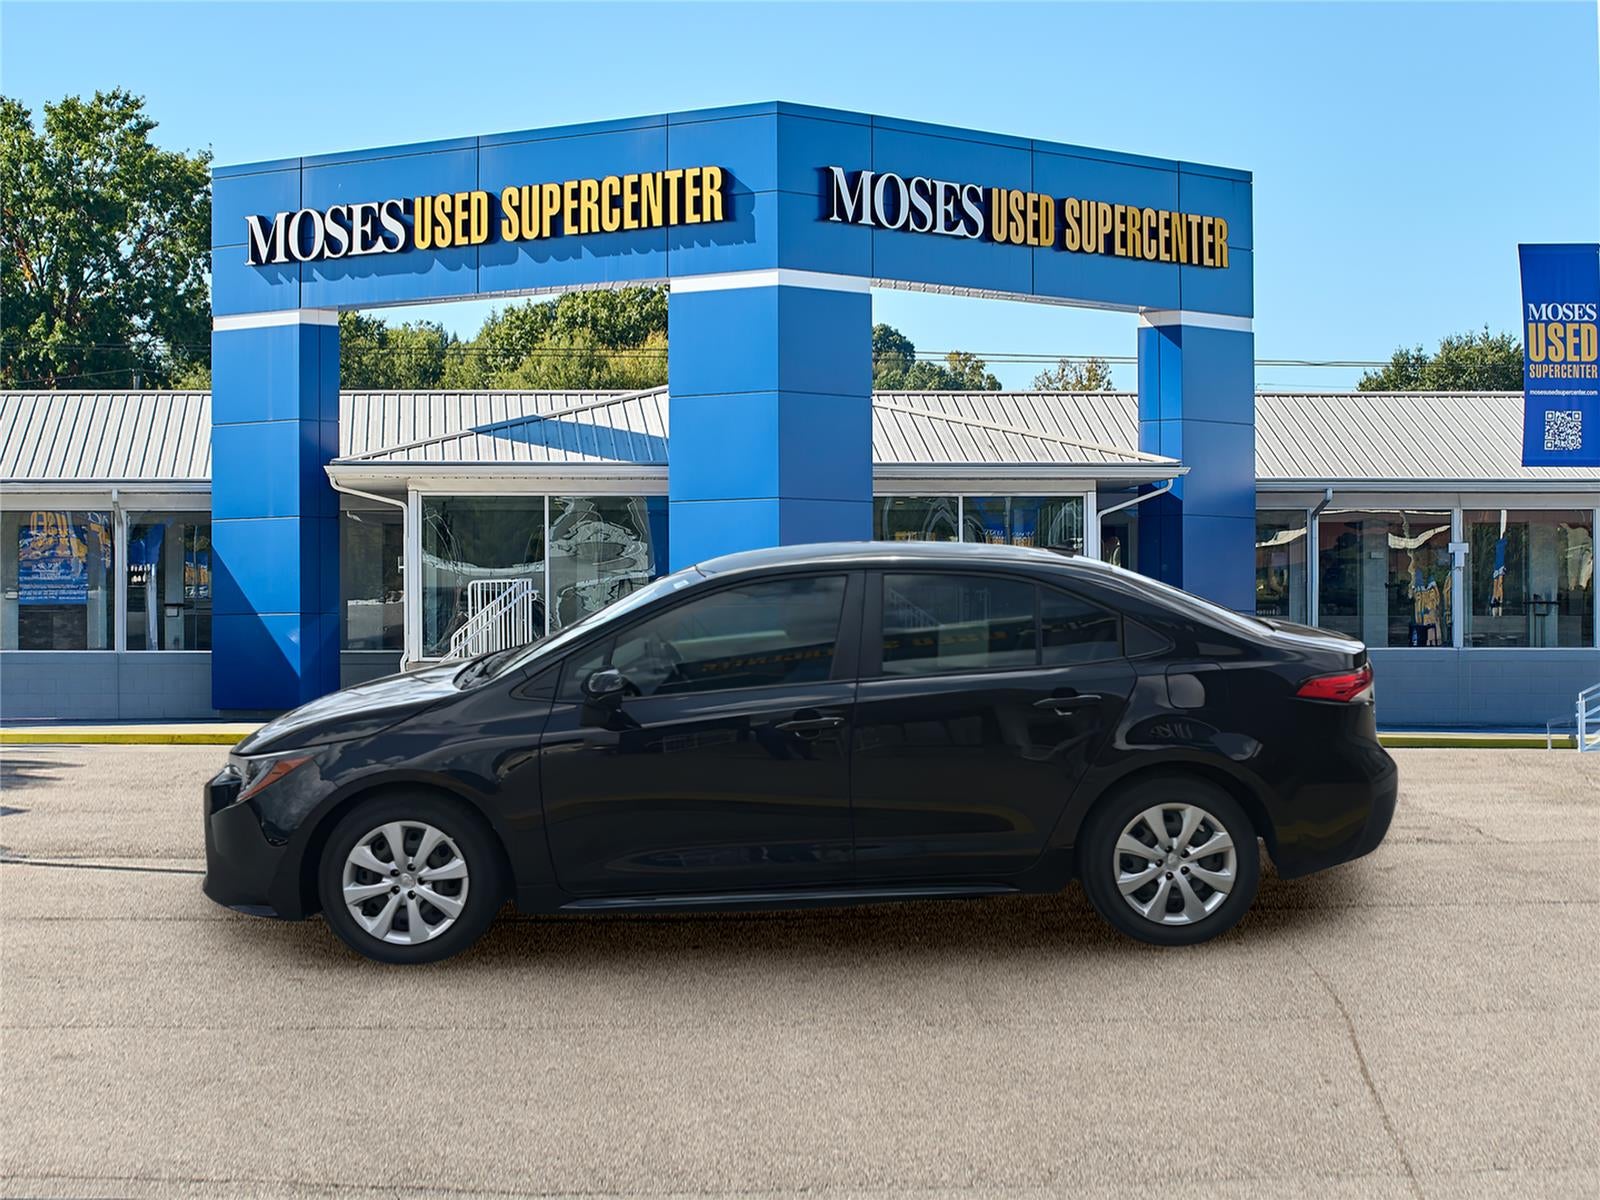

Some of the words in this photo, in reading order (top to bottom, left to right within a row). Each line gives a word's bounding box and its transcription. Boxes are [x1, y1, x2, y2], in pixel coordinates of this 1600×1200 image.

[244, 199, 408, 266] MOSES
[414, 190, 489, 250] USED
[500, 165, 725, 242] SUPERCENTER
[828, 165, 985, 239] MOSES
[991, 187, 1055, 247] USED
[1065, 198, 1230, 269] SUPERCENTER
[1527, 303, 1597, 321] MOSES
[1528, 322, 1598, 362] USED
[1529, 364, 1598, 379] SUPERCENTER
